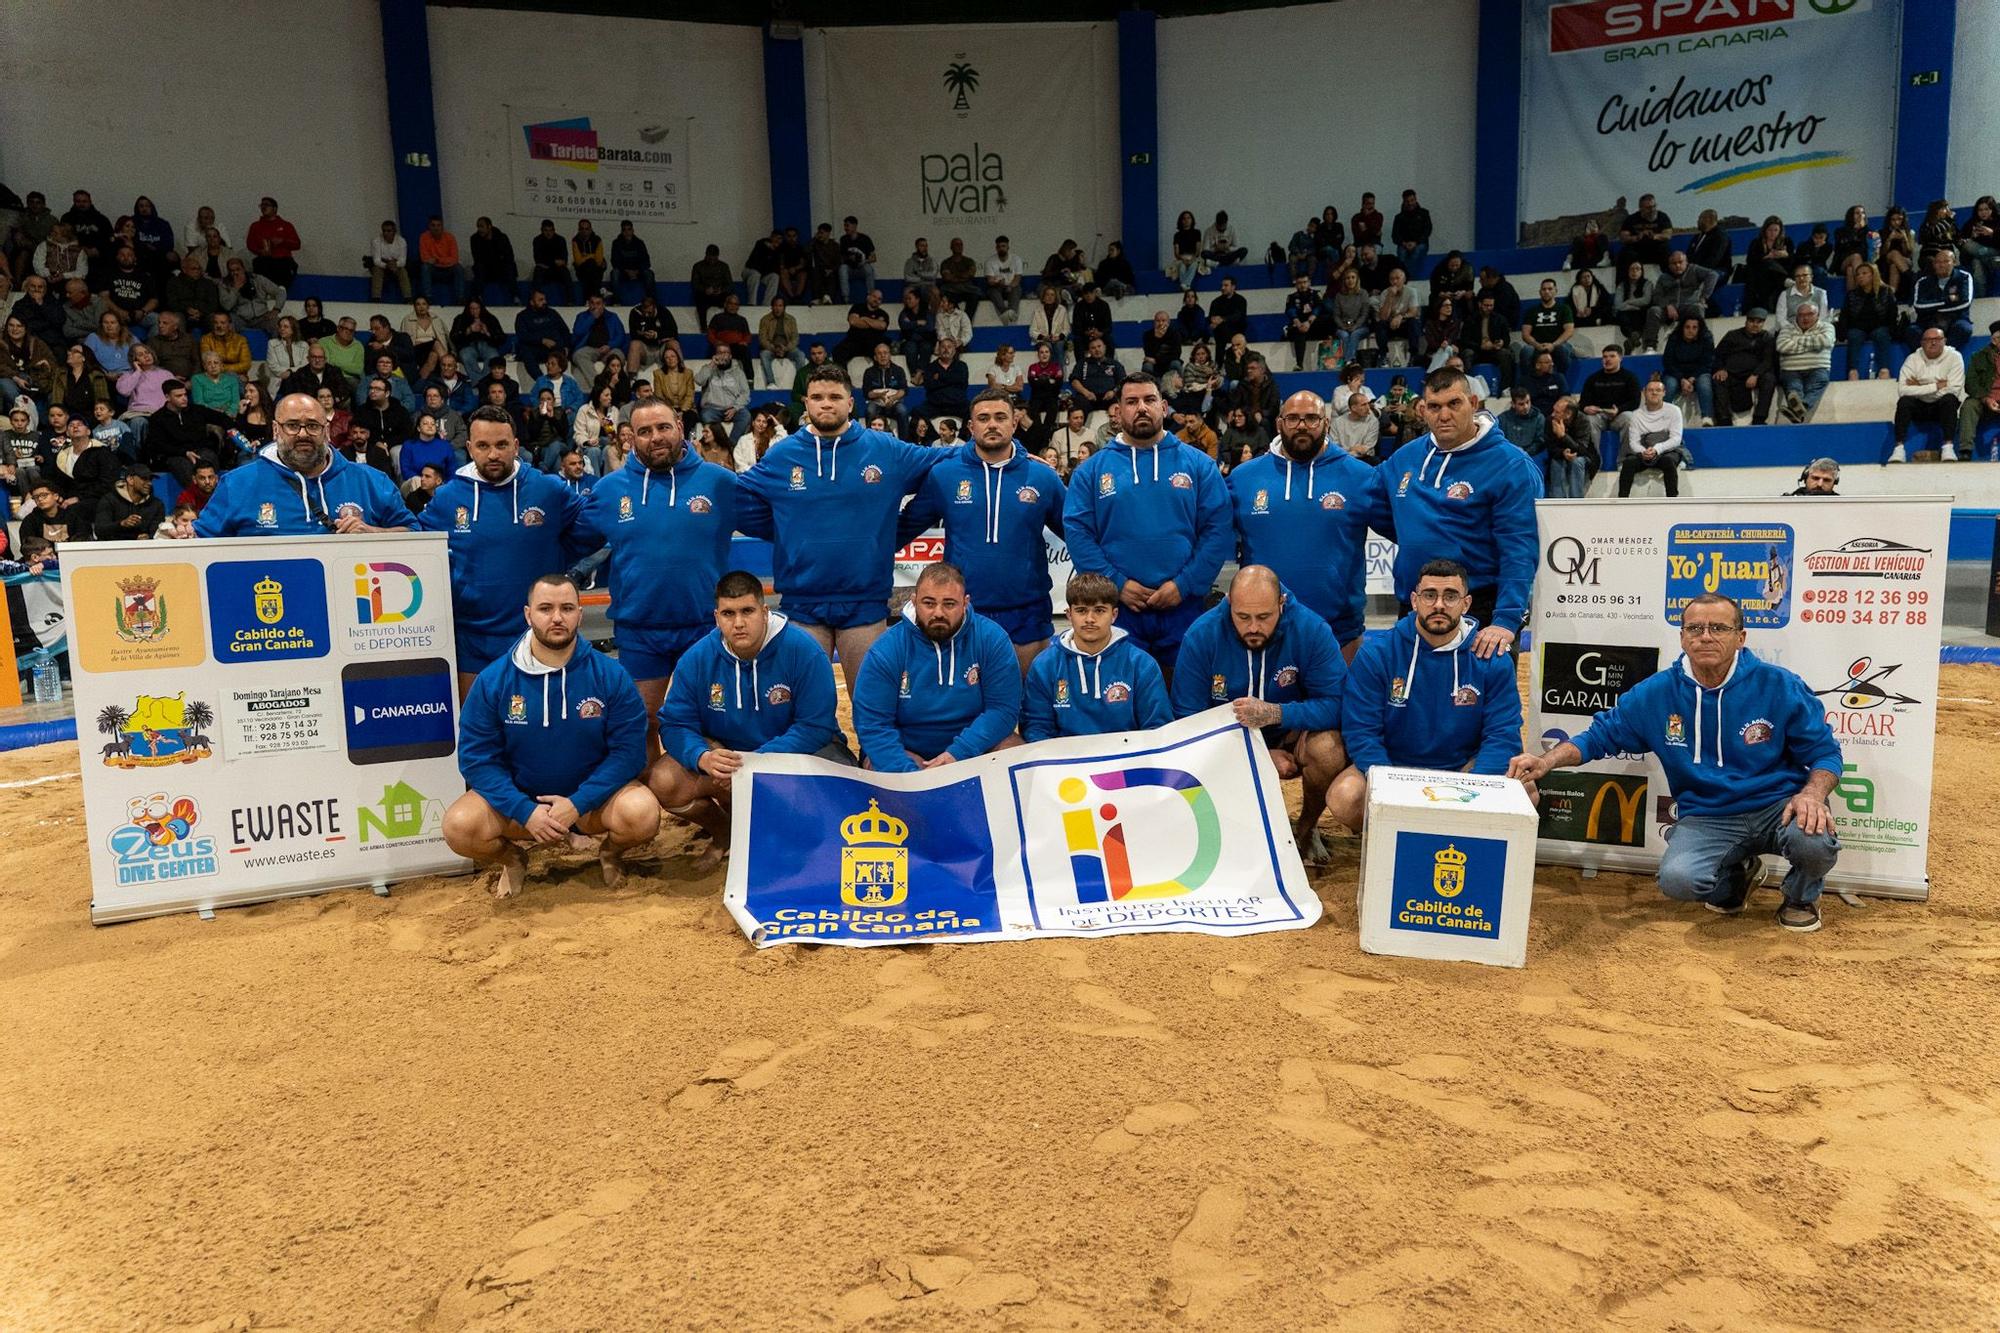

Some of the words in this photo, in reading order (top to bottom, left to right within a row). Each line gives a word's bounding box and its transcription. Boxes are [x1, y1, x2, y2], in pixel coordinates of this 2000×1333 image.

[1604, 43, 1670, 63] GRAN
[1678, 27, 1789, 53] CANARIA
[1597, 75, 1773, 134] Cuidamos
[1649, 129, 1686, 172] lo
[1688, 110, 1827, 165] nuestro
[1619, 536, 1653, 545] MÉNDEZ
[1675, 527, 1735, 539] BAR-CAFETERÍA
[1740, 527, 1786, 539] CHURRERÍA
[1586, 547, 1659, 556] PELUQUEROS
[1808, 556, 1850, 570] GESTION
[1853, 556, 1870, 570] DEL
[1875, 554, 1925, 571] VEHÍCULO
[1704, 552, 1769, 593] Juan
[1884, 572, 1921, 580] CANARIAS
[1567, 595, 1588, 604] 828
[1592, 595, 1606, 604] 05
[1610, 595, 1624, 605] 96
[1628, 596, 1641, 605] 31
[1667, 598, 1677, 609] LA
[1817, 590, 1848, 604] 928
[1854, 590, 1875, 604] 12
[1880, 590, 1901, 605] 36
[1907, 591, 1929, 605] 99
[1815, 609, 1846, 623] 609
[1852, 610, 1873, 624] 34
[1879, 610, 1900, 625] 87
[1905, 611, 1927, 625] 88
[235, 628, 286, 641] Cabildo
[288, 626, 304, 638] de
[230, 641, 262, 652] Gran
[265, 637, 314, 650] Canaria
[369, 636, 432, 650] DEPORTES
[1576, 652, 1607, 686] G
[1608, 664, 1625, 672] ALU
[233, 691, 268, 701] Domingo
[269, 688, 302, 700] Tarajano
[303, 687, 321, 695] Mesa
[252, 699, 306, 710] ABOGADOS
[371, 702, 448, 719] CANARAGUA
[260, 723, 276, 731] 928
[307, 719, 318, 727] 37
[1824, 711, 1895, 737] CICAR
[260, 733, 277, 741] 928
[294, 730, 305, 738] 95
[307, 729, 319, 737] 04
[1852, 737, 1878, 746] Islands
[1881, 739, 1896, 747] Car
[231, 798, 341, 844] EWASTE
[1851, 816, 1918, 834] archipielago
[112, 827, 213, 864] Zeus
[244, 848, 336, 869] www.ewaste.es
[119, 863, 155, 883] DIVE
[158, 857, 215, 879] CENTER
[775, 909, 905, 923] Cabildo
[915, 909, 956, 919] de
[1108, 906, 1259, 924] DEPORTES
[1406, 899, 1462, 915] Cabildo
[1464, 905, 1483, 917] de
[758, 921, 839, 935] Gran
[849, 917, 981, 934] Canaria
[1399, 911, 1433, 925] Gran
[1437, 915, 1492, 931] Canaria
